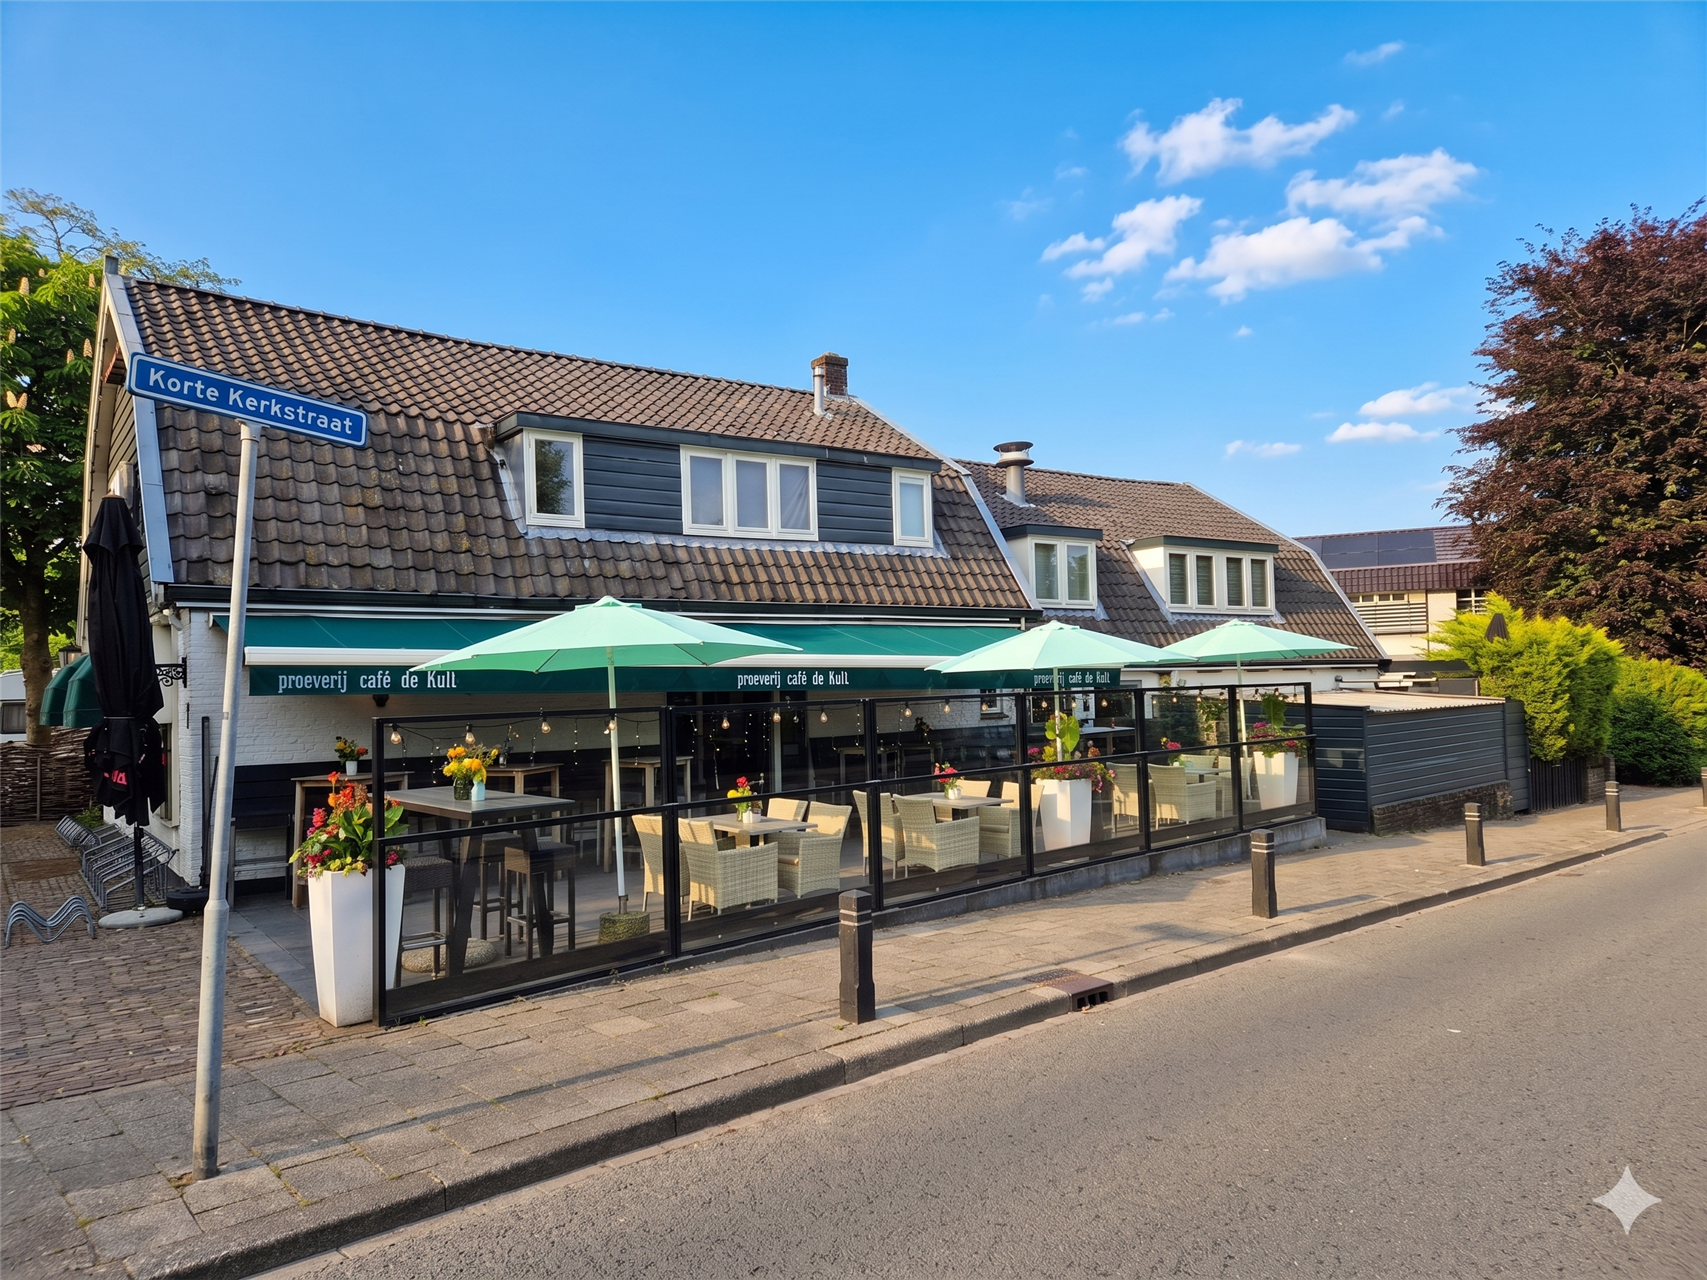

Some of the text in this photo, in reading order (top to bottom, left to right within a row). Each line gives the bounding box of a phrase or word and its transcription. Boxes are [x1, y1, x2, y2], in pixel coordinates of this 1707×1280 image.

[149, 367, 354, 434] Korte Kerkstraat
[278, 670, 348, 693] proeverij
[359, 670, 391, 689] café
[401, 670, 418, 688] de
[737, 670, 781, 689] proeverij
[787, 670, 807, 685] café
[812, 670, 824, 685] de
[1033, 672, 1065, 687] proevrij
[1068, 671, 1082, 684] café
[1085, 672, 1094, 683] de
